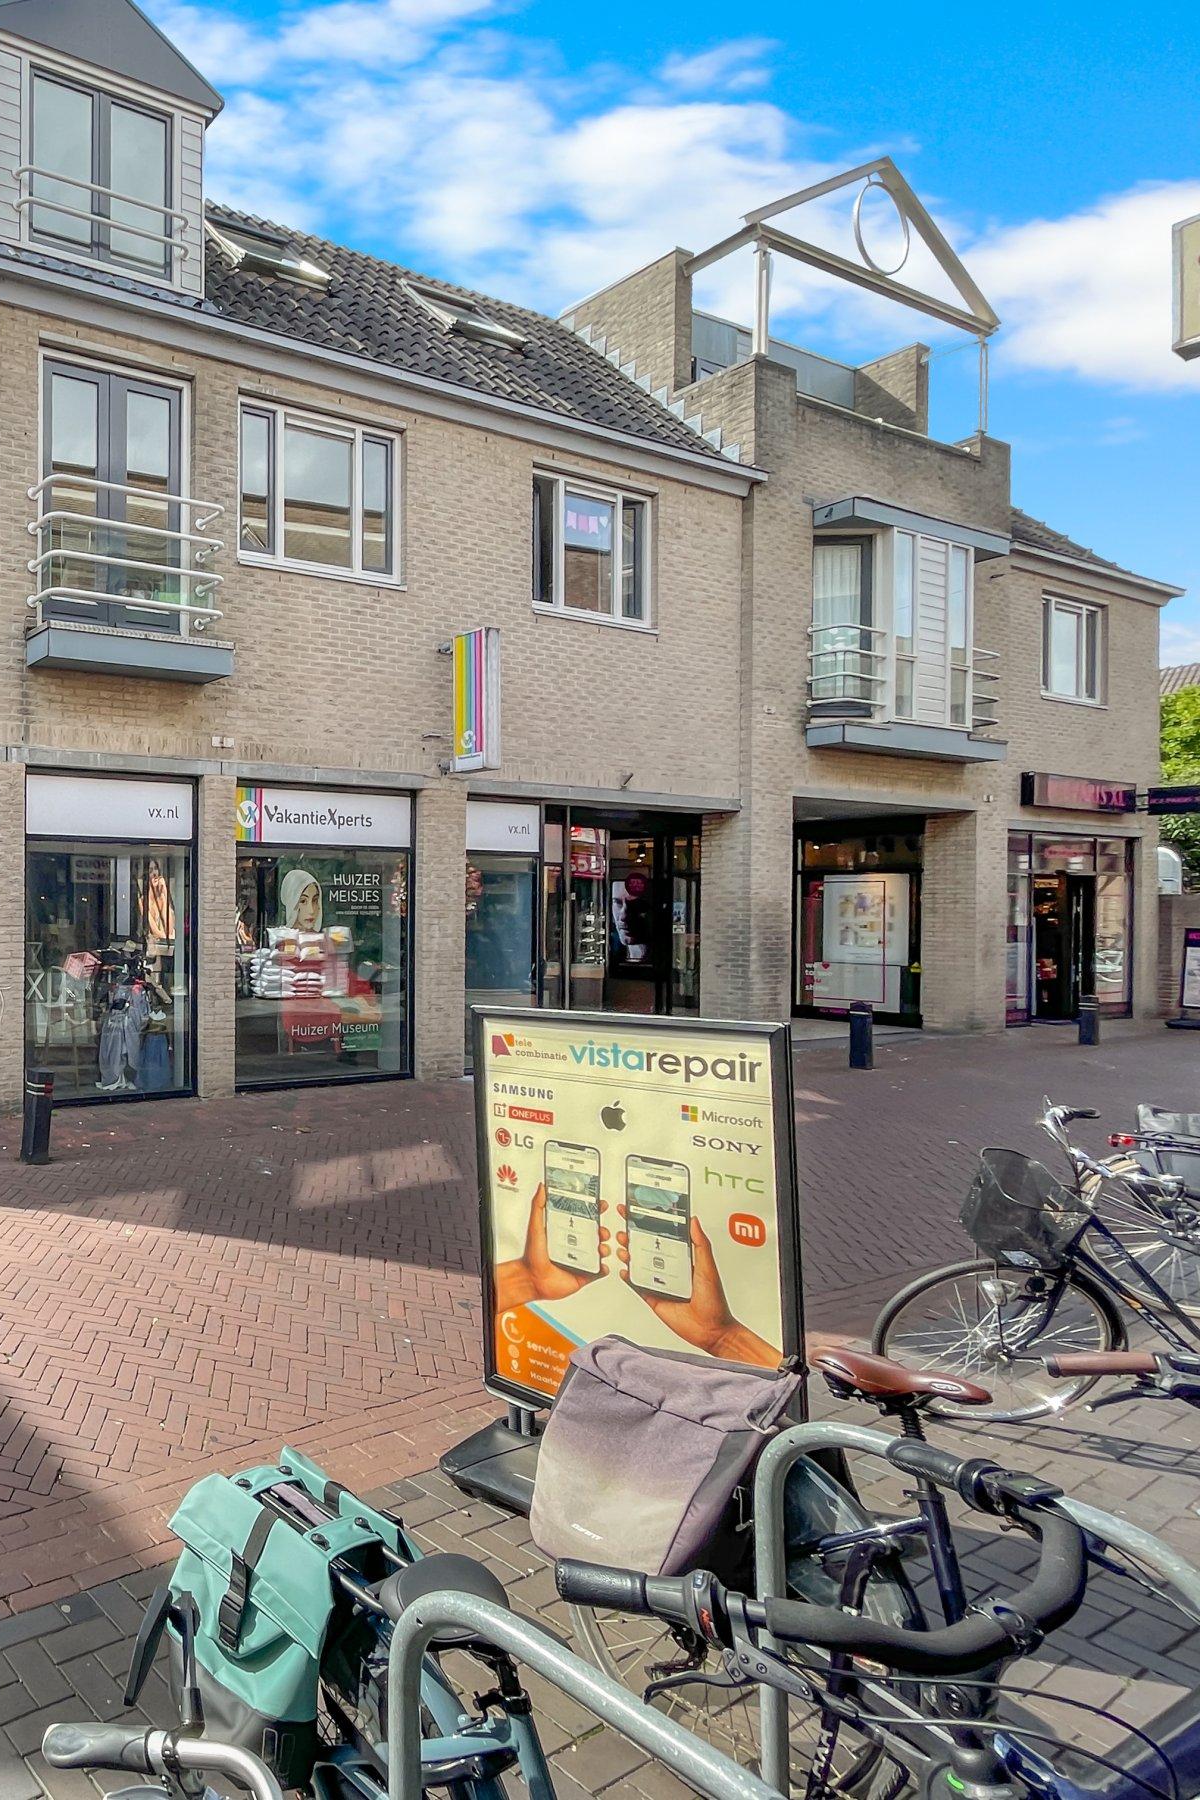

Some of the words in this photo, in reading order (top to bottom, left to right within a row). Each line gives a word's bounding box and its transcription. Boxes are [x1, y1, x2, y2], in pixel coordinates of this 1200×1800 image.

[148, 805, 179, 819] vx.nl
[264, 804, 372, 829] VakantieXperts
[508, 823, 530, 835] vx.nl
[333, 873, 380, 886] HUIZER
[329, 889, 380, 902] MEISJES
[291, 1023, 329, 1037] Huizer
[332, 1022, 379, 1034] Museum
[515, 1038, 533, 1048] tele
[515, 1049, 568, 1062] combinatie
[569, 1039, 763, 1084] vistarepair
[493, 1082, 554, 1100] SAMSUNG
[511, 1108, 551, 1122] ONEPLUS
[702, 1110, 764, 1129] Microsoft
[514, 1132, 534, 1150] LG
[692, 1135, 763, 1156] SONY
[530, 1371, 561, 1388] Haarle
